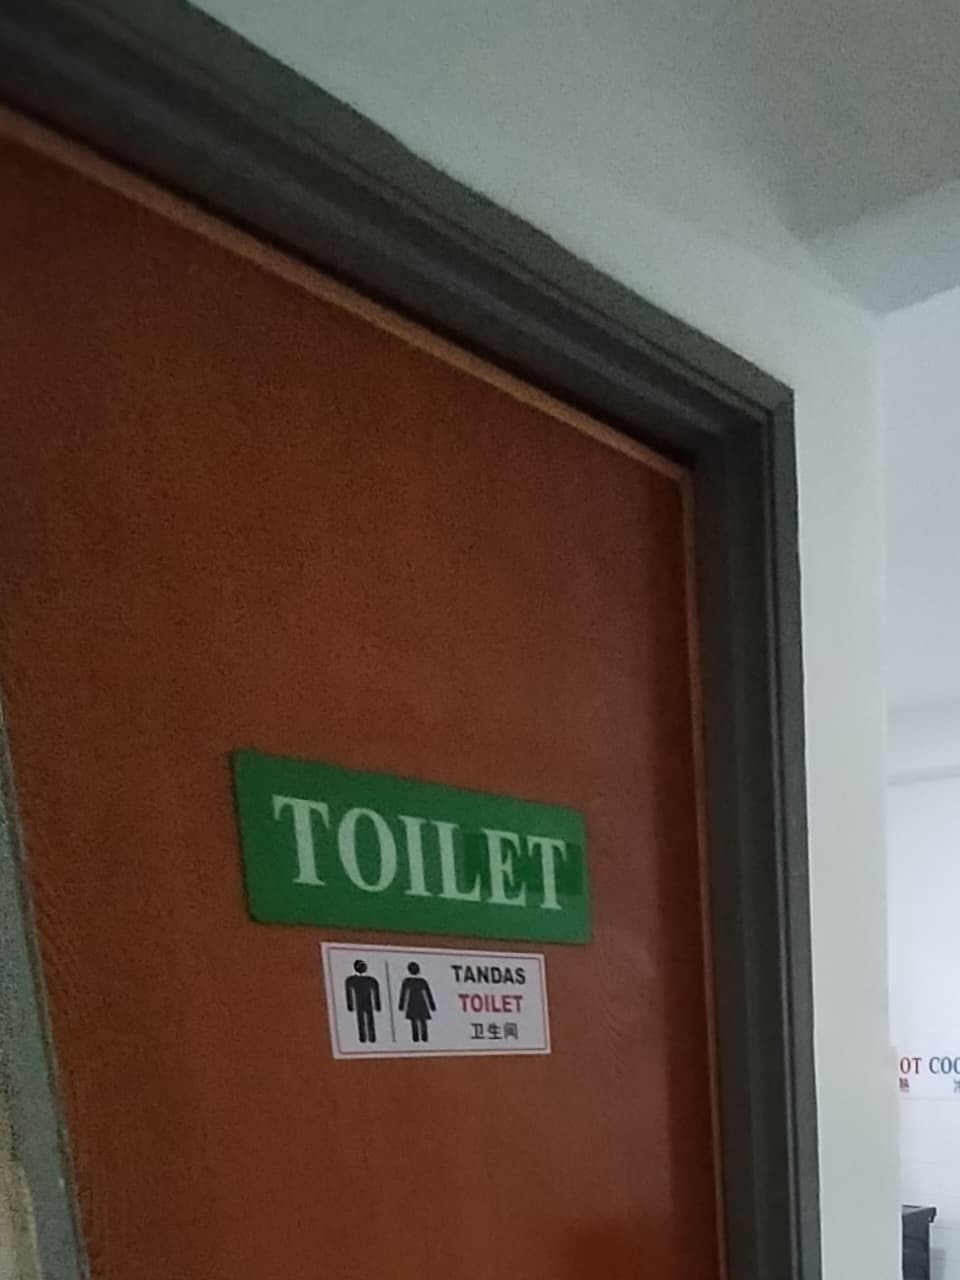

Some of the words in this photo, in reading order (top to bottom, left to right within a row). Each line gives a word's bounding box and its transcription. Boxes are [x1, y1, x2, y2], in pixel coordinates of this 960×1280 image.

[272, 795, 567, 911] TOILET
[451, 964, 526, 985] TANDAS
[458, 993, 523, 1013] TOILET
[470, 1022, 519, 1040] 卫生间
[899, 1056, 922, 1074] OT
